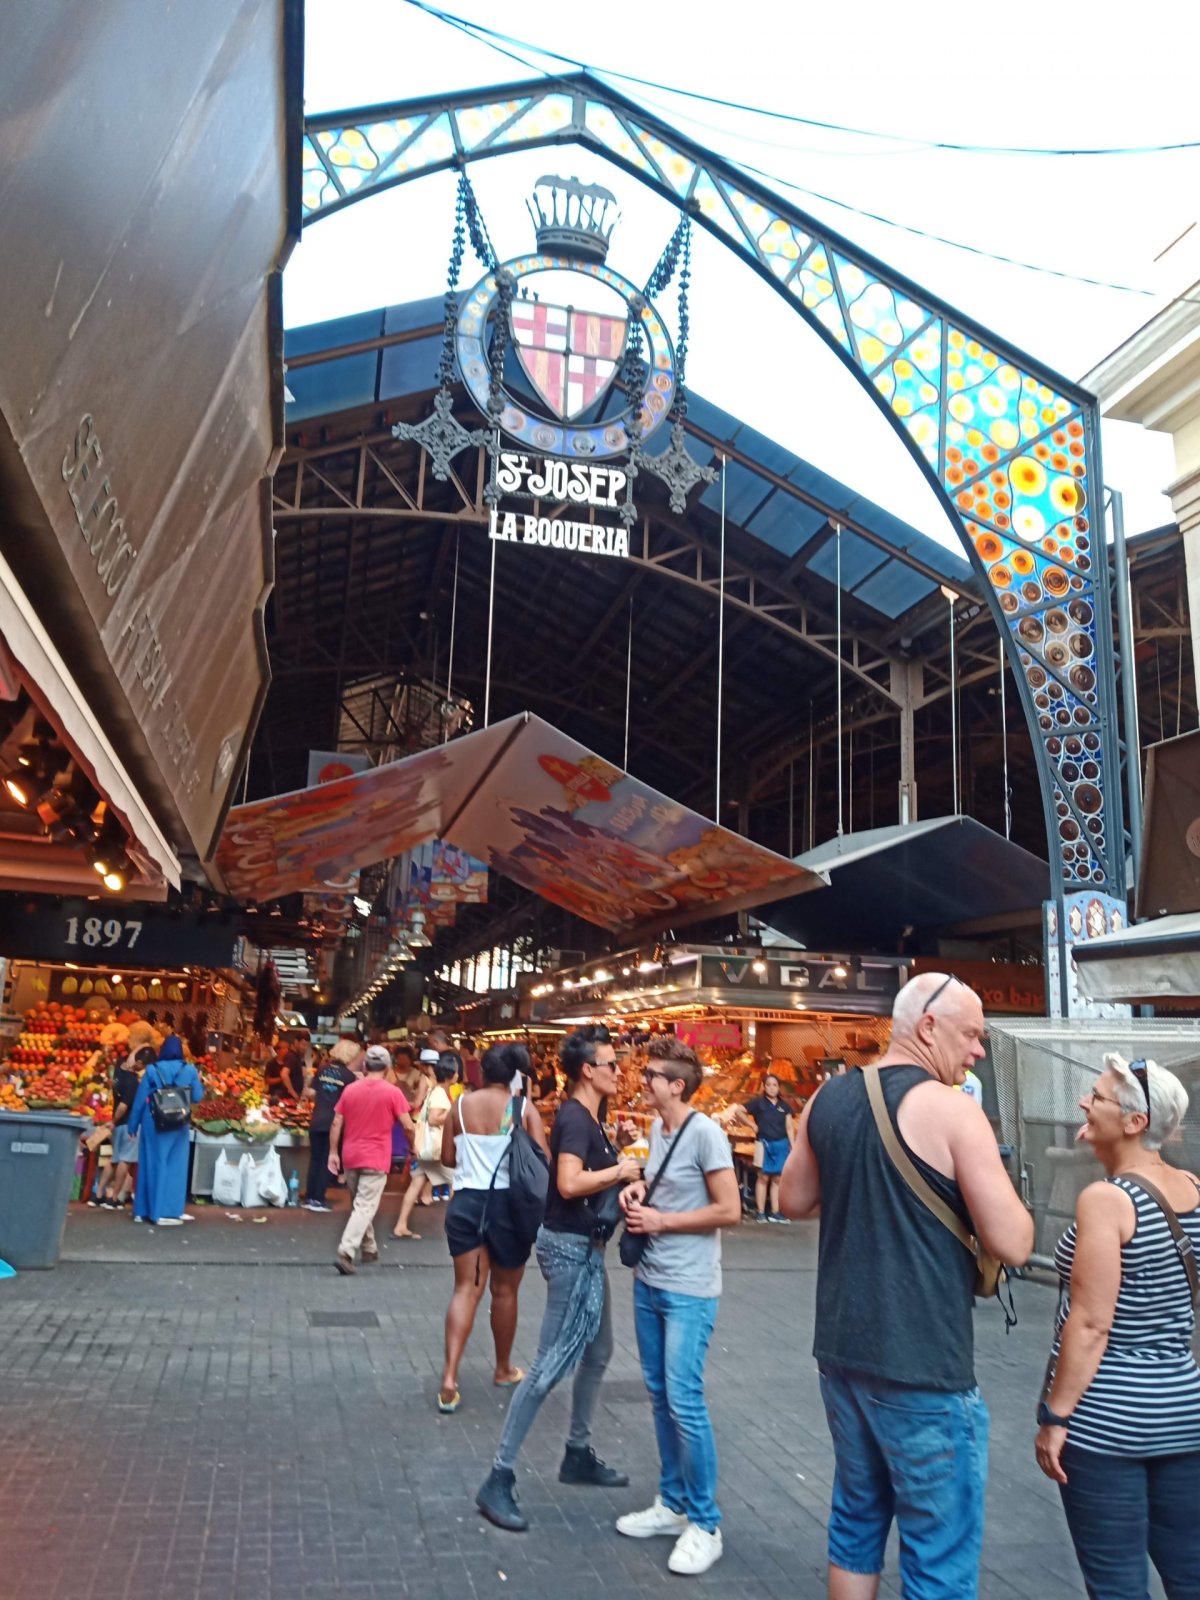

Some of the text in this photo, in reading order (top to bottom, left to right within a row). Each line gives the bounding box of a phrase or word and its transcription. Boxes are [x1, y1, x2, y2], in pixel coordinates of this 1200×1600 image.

[527, 459, 627, 507] JOSEP
[488, 509, 630, 558] LA BOQUERIA
[64, 916, 143, 949] 1897
